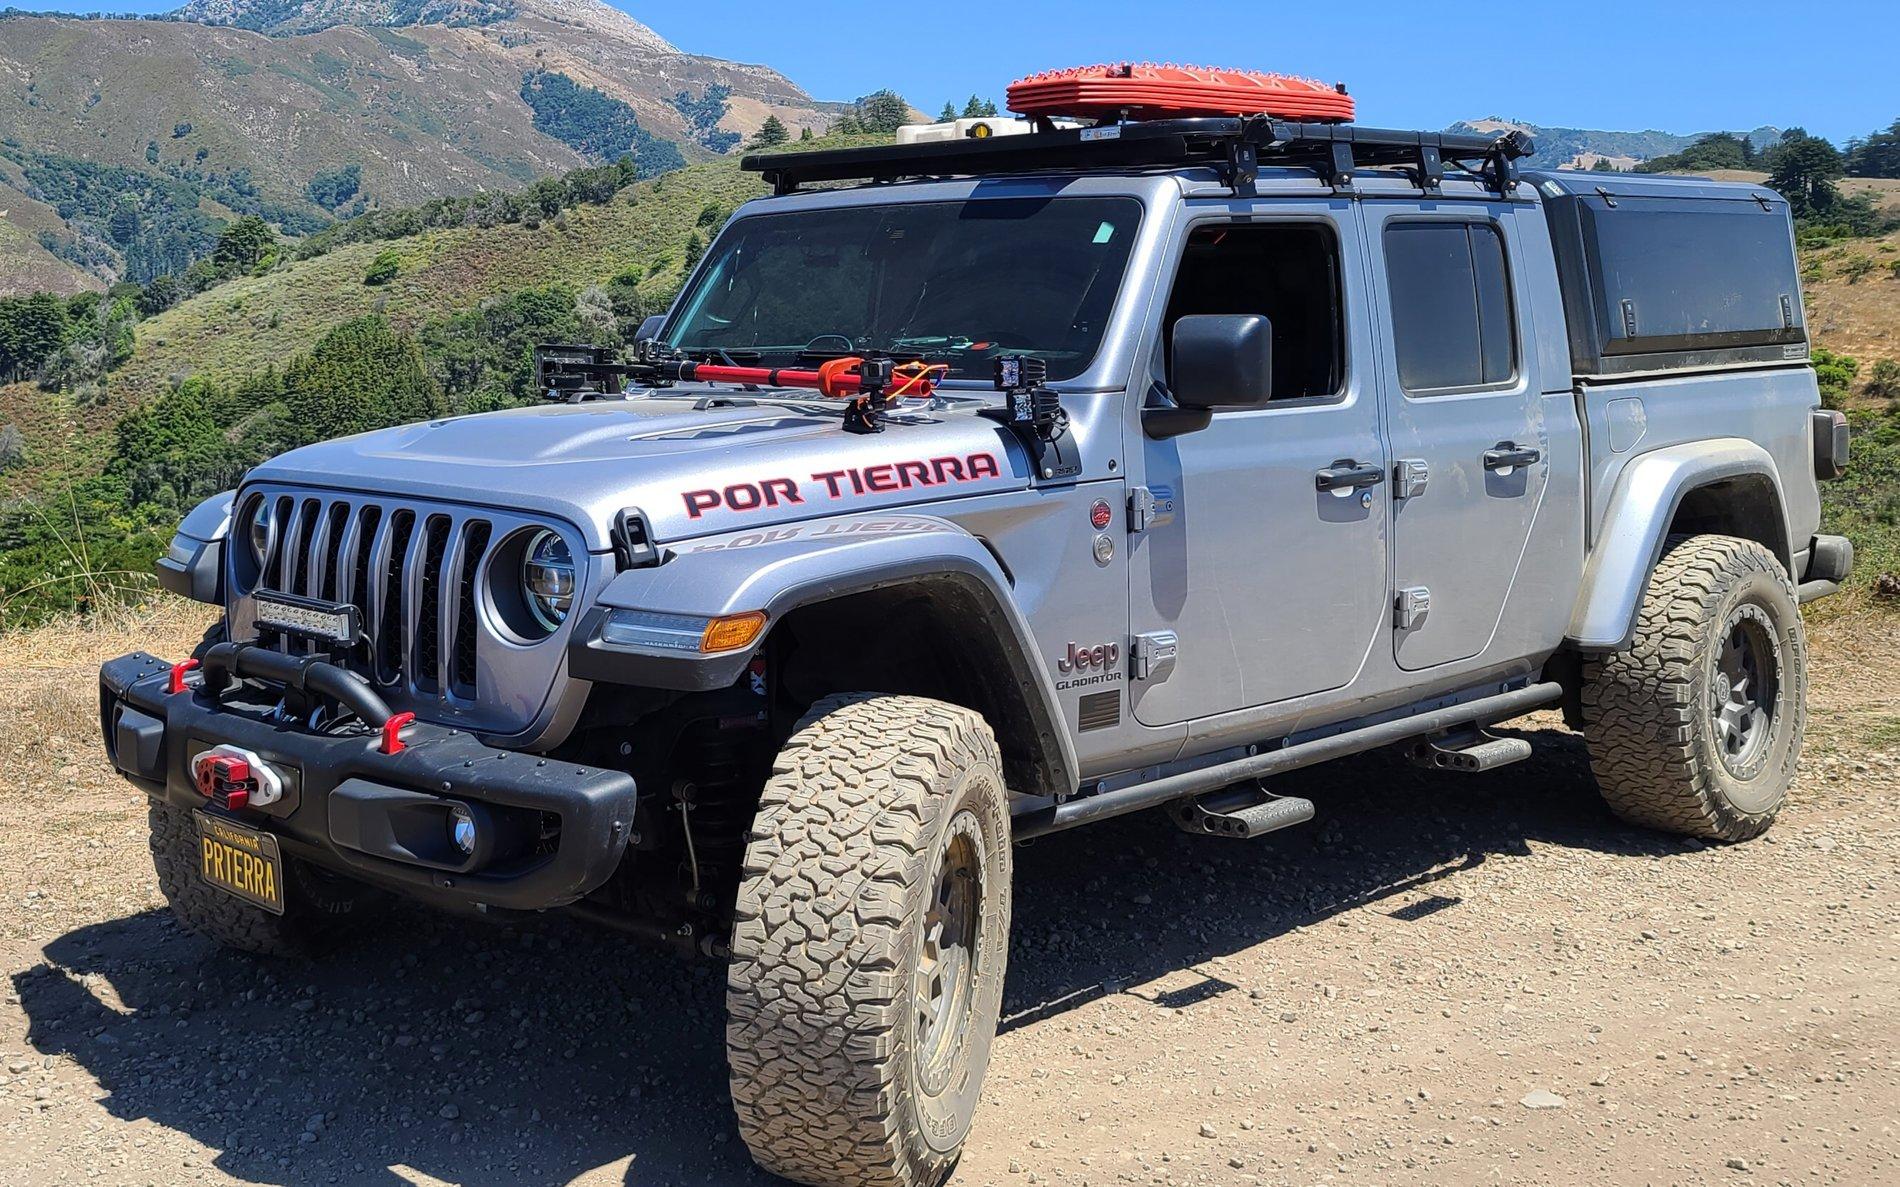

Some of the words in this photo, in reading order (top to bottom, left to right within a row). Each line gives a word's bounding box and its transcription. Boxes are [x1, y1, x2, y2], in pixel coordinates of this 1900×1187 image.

[681, 477, 806, 520] POR
[810, 452, 1001, 499] TIERRA
[1058, 641, 1119, 673] Jeep
[1056, 672, 1122, 691] GLADIATOR
[214, 825, 260, 850] CALIFORNIA
[203, 837, 276, 901] PRTERRA
